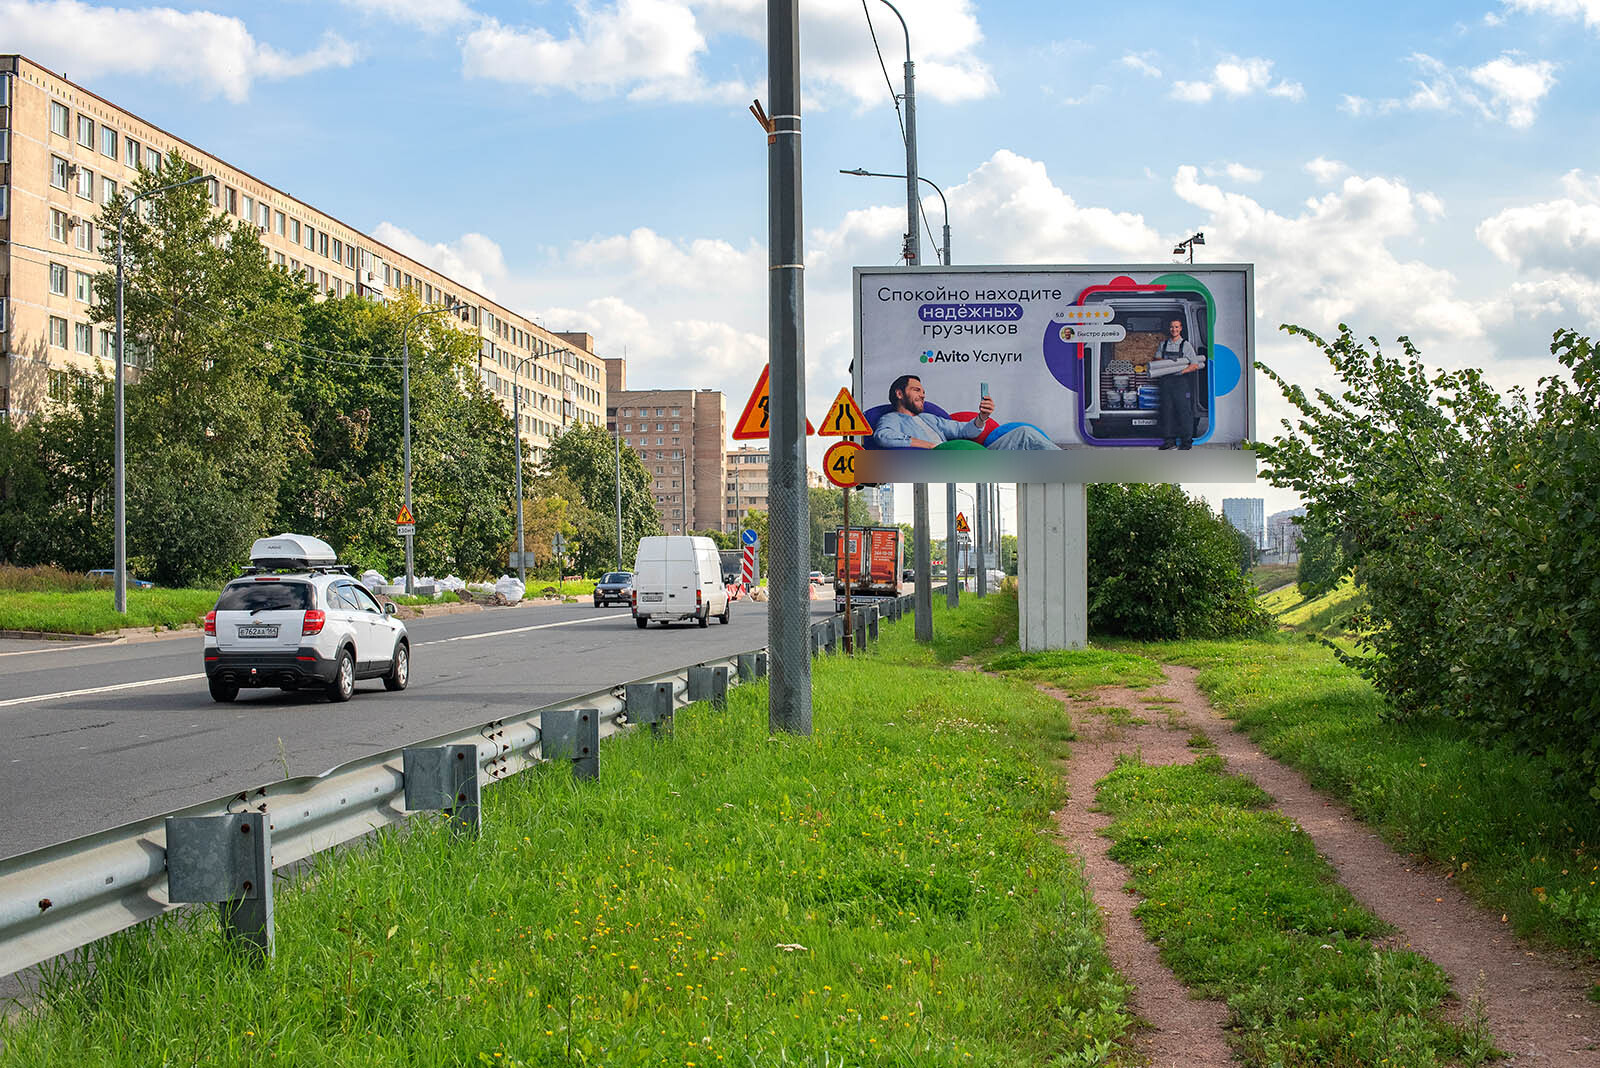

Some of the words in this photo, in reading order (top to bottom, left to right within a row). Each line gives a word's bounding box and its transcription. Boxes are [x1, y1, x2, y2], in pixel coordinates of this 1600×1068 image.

[877, 286, 970, 302] Спокойно
[975, 289, 1062, 302] находите
[923, 304, 1018, 320] надёжных
[923, 324, 1018, 339] грузчиков
[1077, 331, 1101, 339] Быстро
[935, 350, 970, 363] Avito
[973, 350, 1022, 365] Услуги
